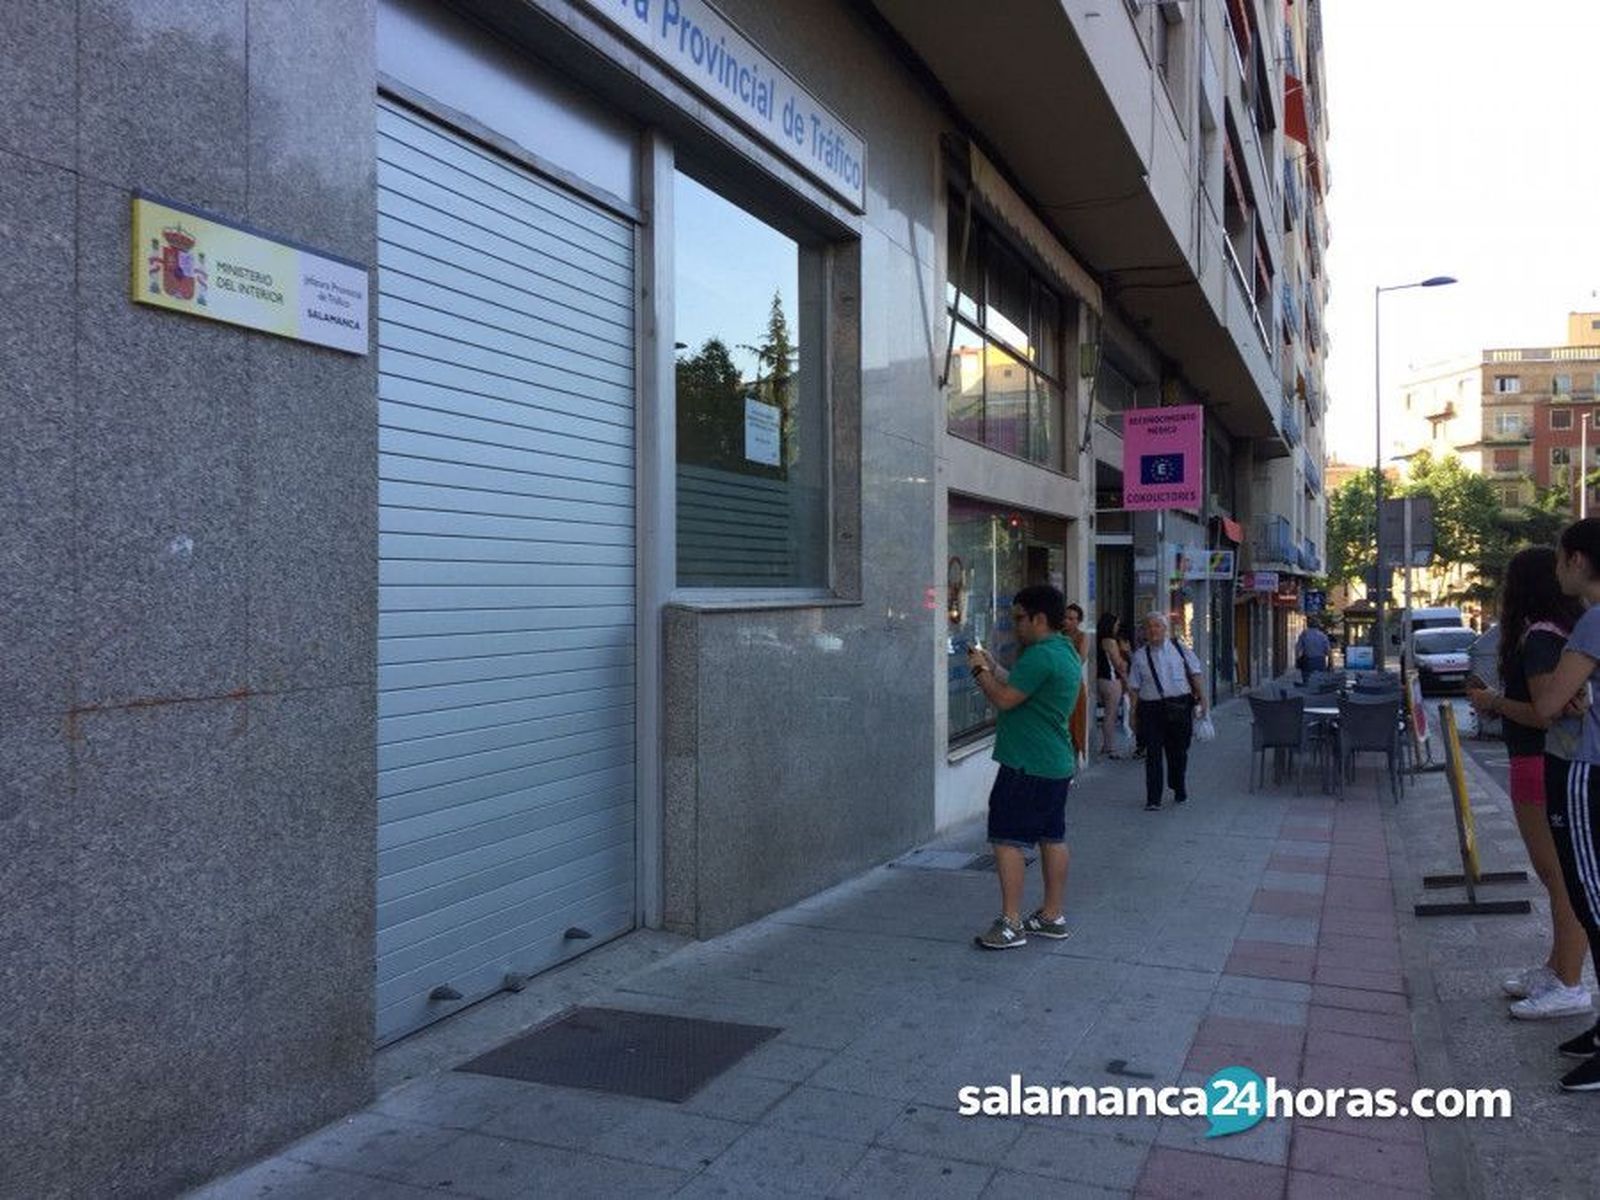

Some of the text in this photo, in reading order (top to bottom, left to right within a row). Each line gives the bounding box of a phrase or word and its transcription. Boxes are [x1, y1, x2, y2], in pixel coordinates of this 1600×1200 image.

[661, 0, 774, 122] Provincial
[782, 94, 804, 146] de
[810, 113, 860, 190] Tráfico
[216, 260, 272, 286] MINISTERIO
[216, 275, 284, 305] DEL INTERIOR
[307, 308, 360, 330] SALAMANCA
[1157, 463, 1166, 475] E
[1126, 491, 1197, 504] CONDUCTORES
